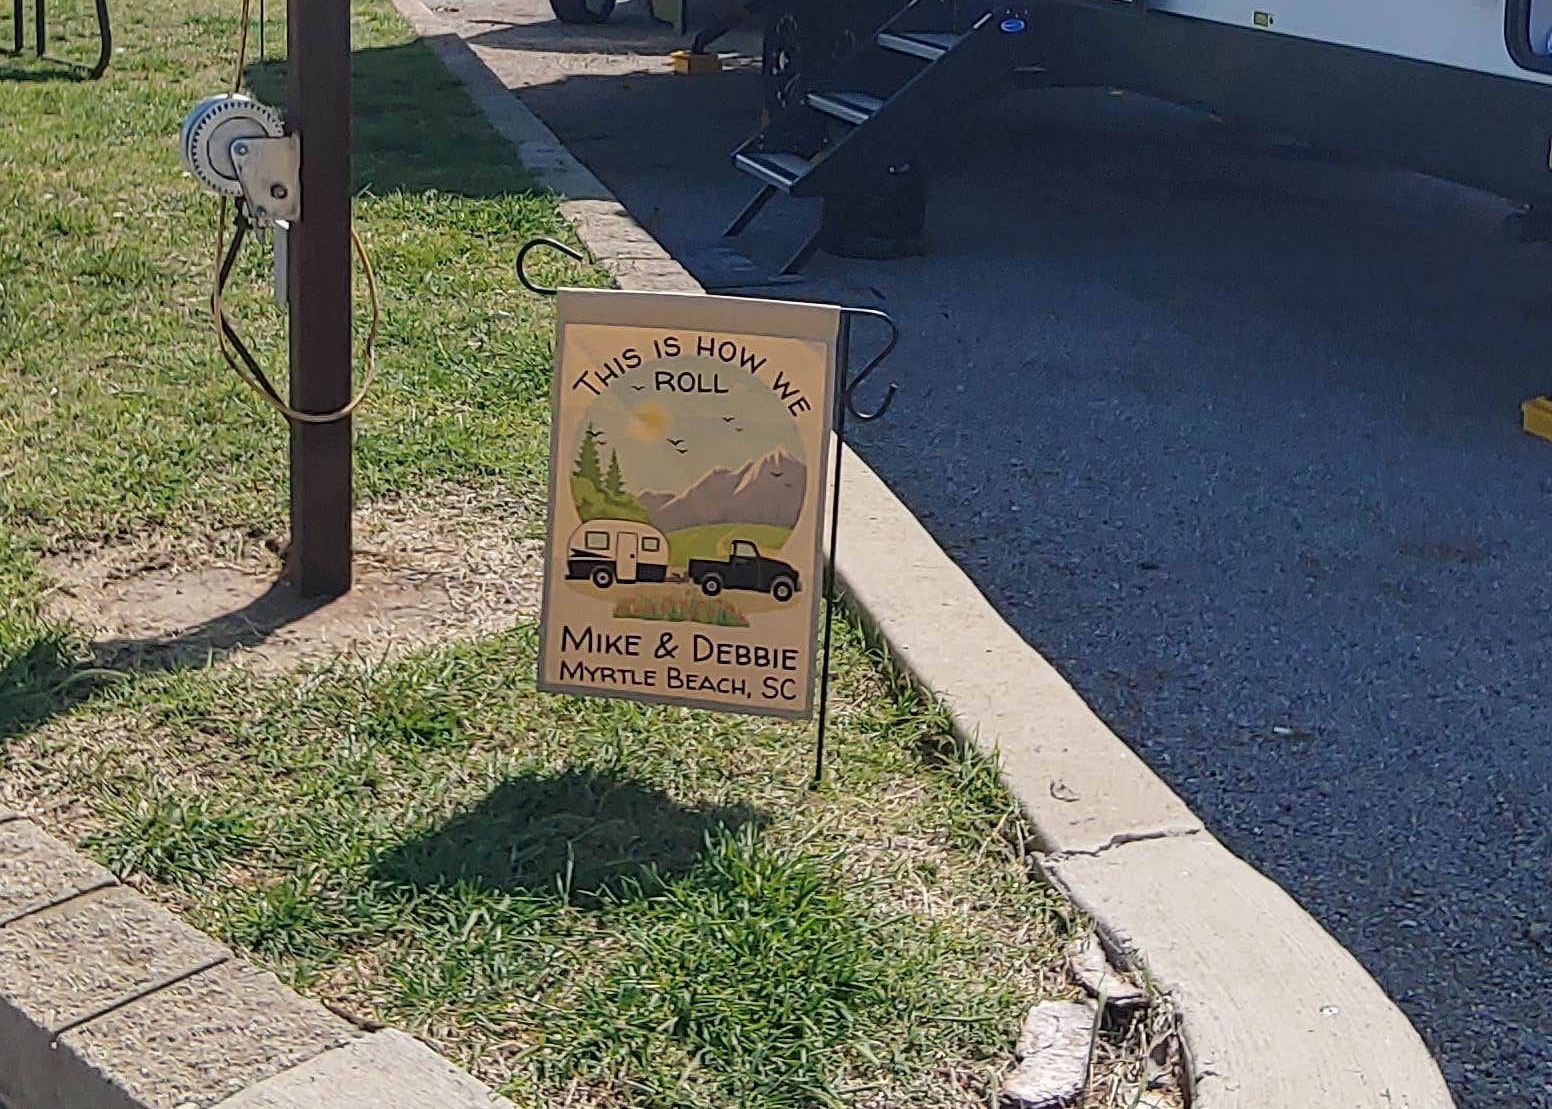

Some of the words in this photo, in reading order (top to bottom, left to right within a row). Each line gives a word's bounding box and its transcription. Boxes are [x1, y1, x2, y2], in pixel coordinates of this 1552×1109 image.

[572, 347, 643, 396] THIS
[653, 335, 682, 359] IS
[696, 335, 768, 375] HOW
[772, 371, 812, 417] WE
[654, 371, 729, 394] ROLL
[560, 625, 642, 657] MIKE
[654, 631, 679, 660] &
[693, 633, 799, 671] DEBBIE
[559, 659, 657, 687] MYRTLE
[666, 666, 752, 699] BEACH,
[761, 676, 797, 701] SC
